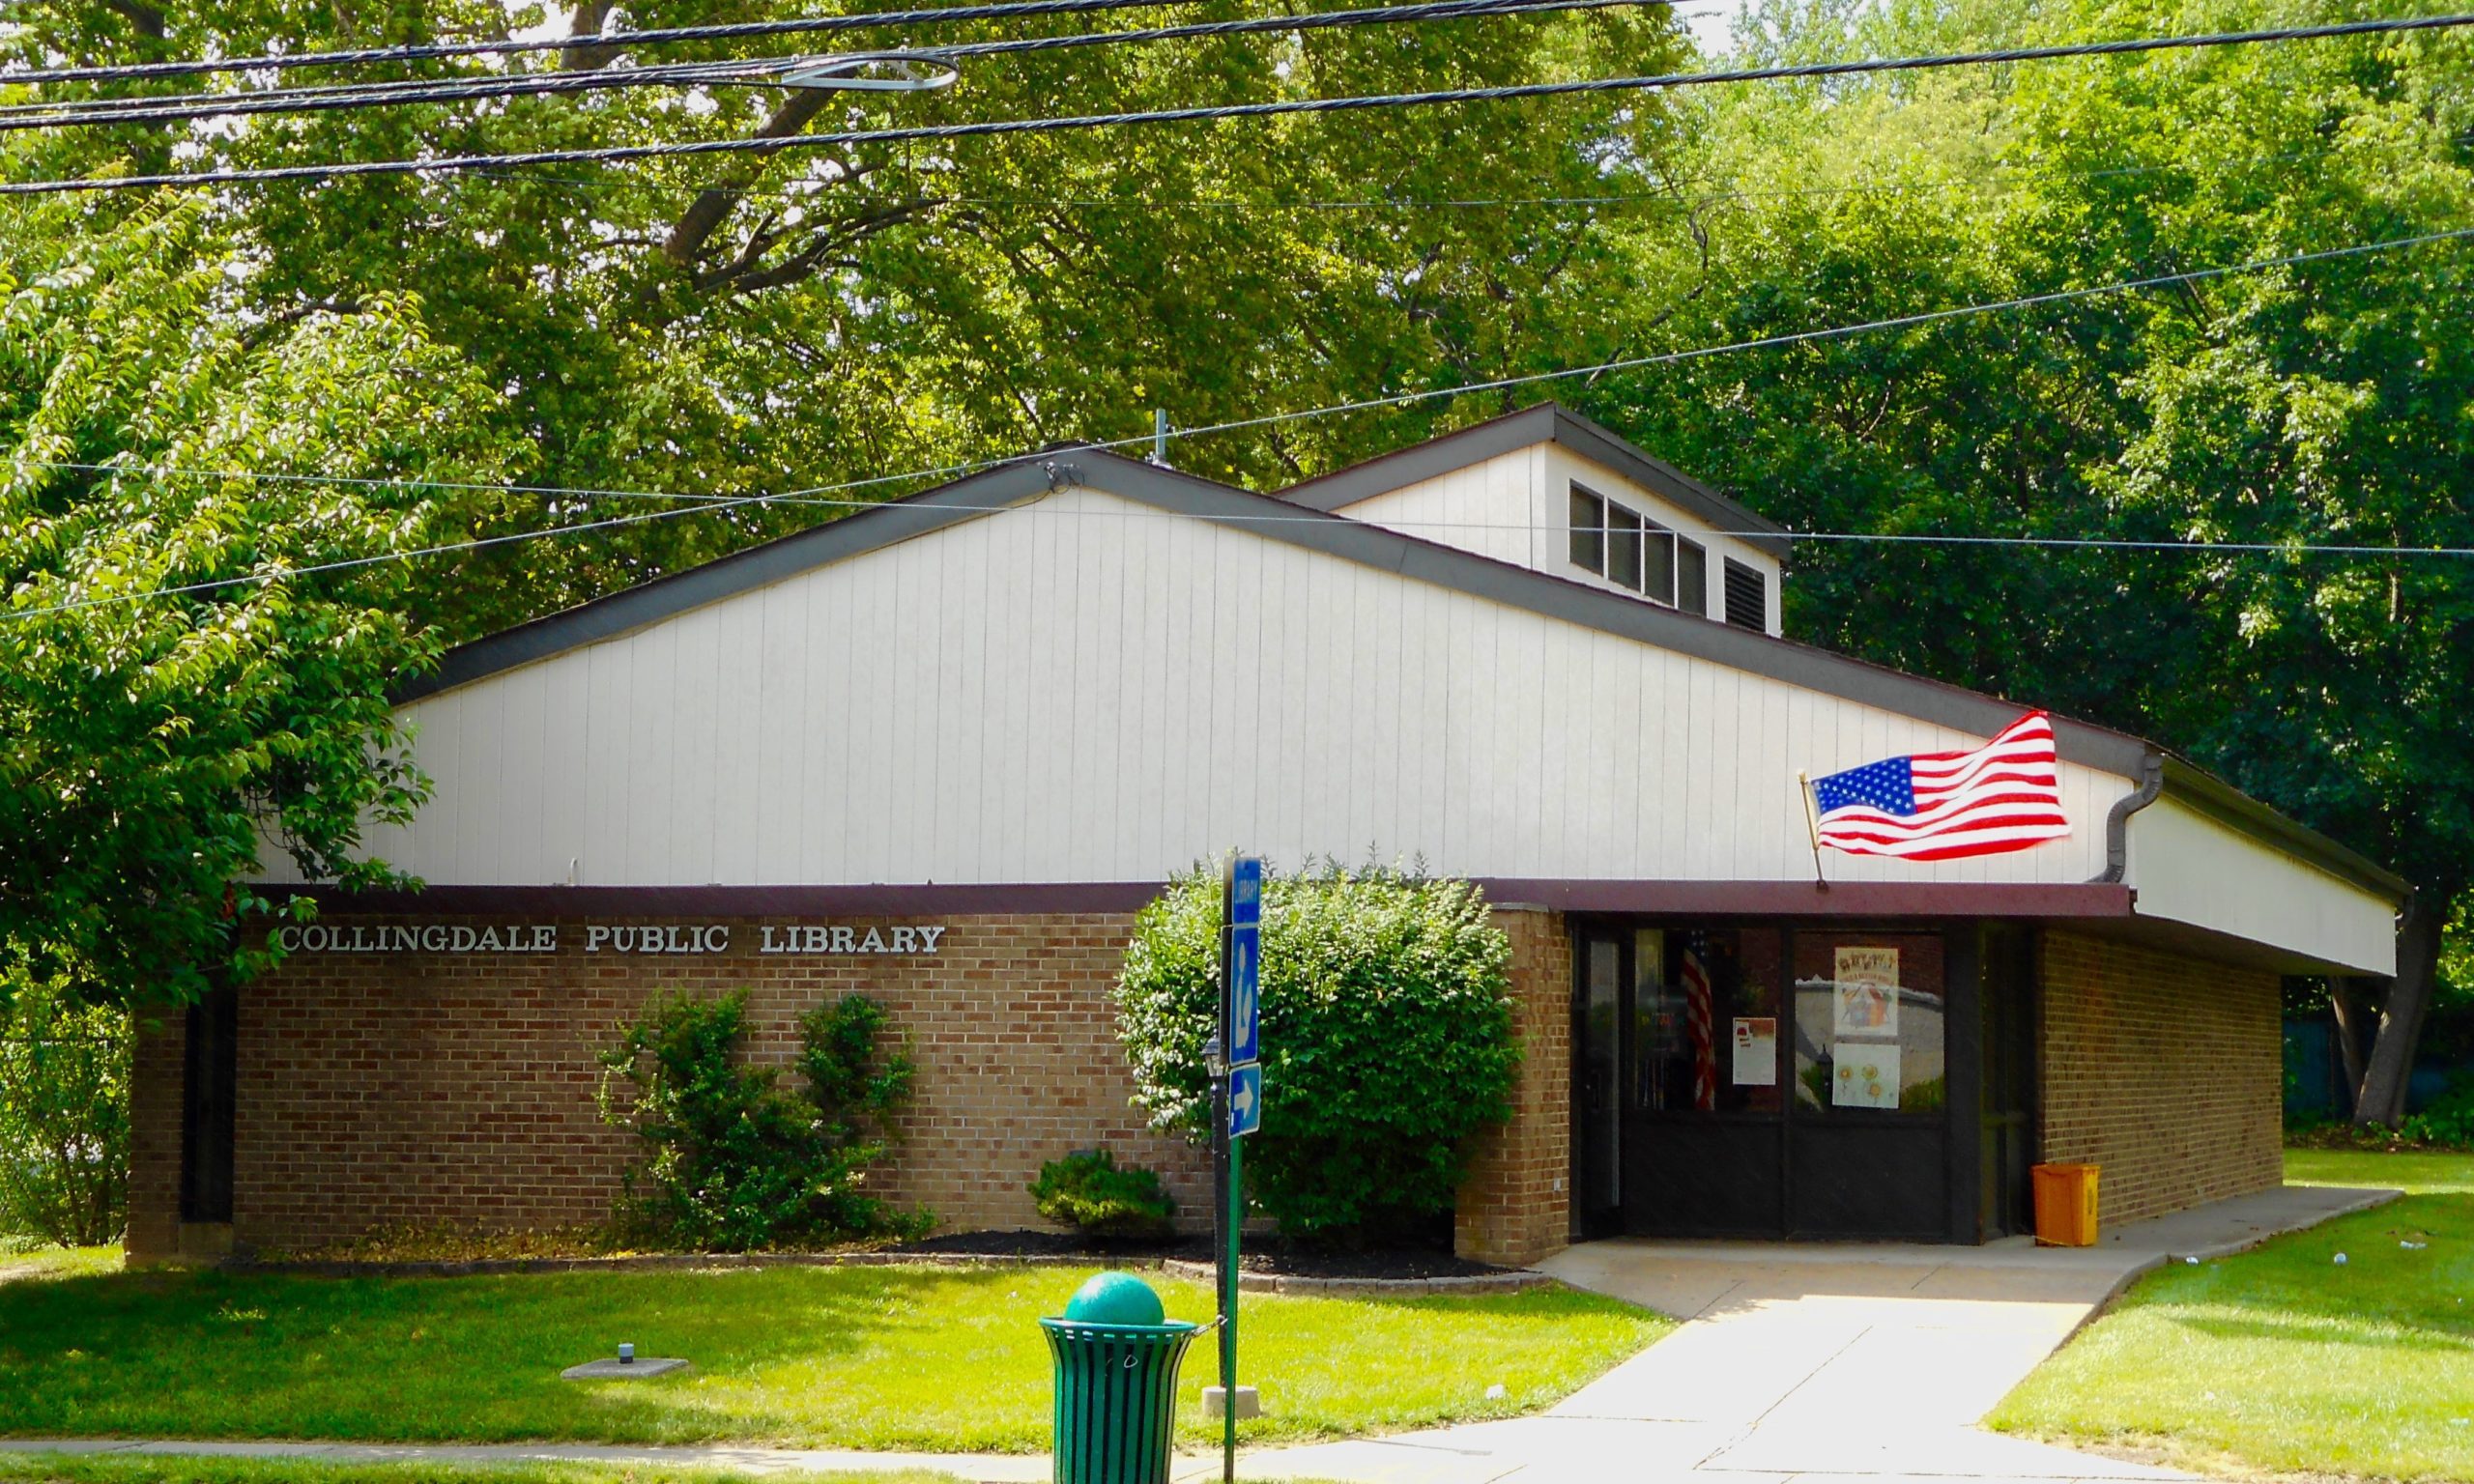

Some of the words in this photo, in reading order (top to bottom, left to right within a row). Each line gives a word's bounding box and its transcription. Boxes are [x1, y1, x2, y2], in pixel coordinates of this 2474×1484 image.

[279, 926, 557, 952] COLLINGDALE
[585, 926, 730, 952] PUBLIC
[760, 926, 945, 953] LIBRARY
